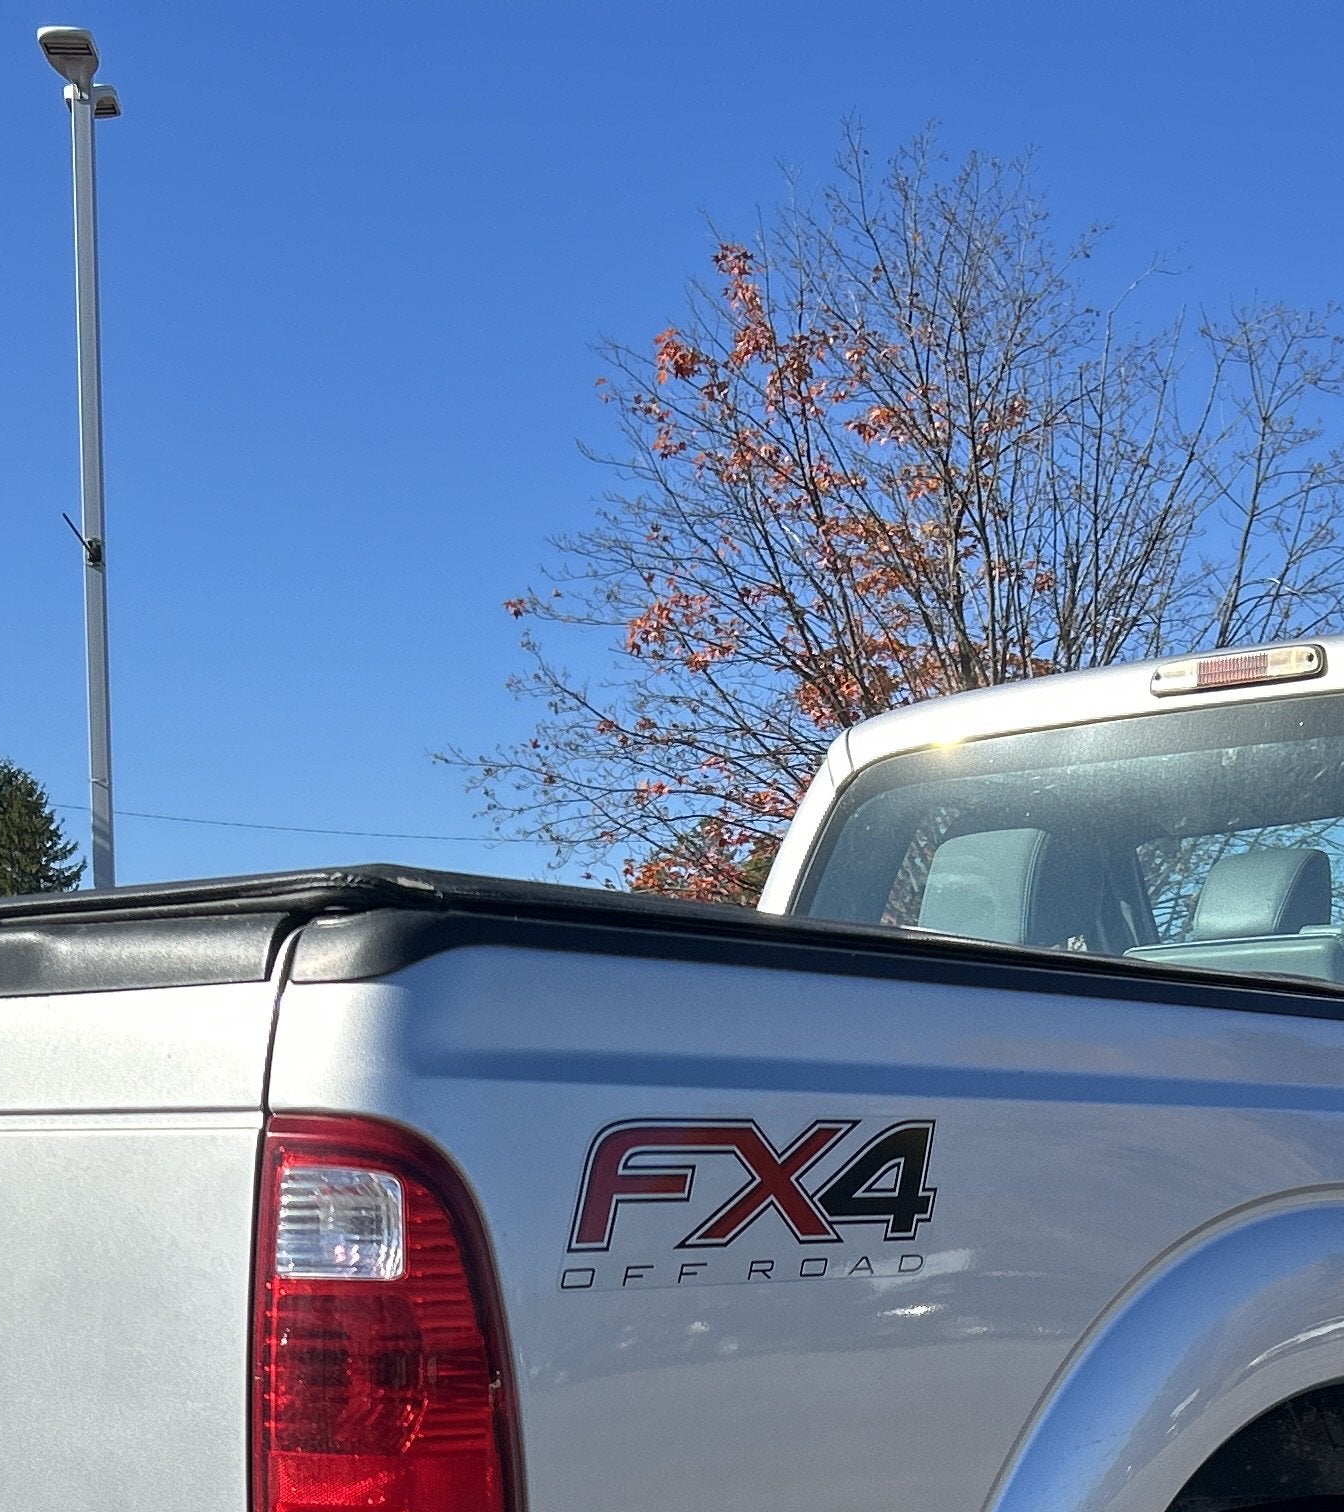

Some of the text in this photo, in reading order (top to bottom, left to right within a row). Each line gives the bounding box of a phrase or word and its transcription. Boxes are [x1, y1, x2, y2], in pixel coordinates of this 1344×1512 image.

[566, 1118, 938, 1253] FX4
[560, 1254, 925, 1290] OFF ROAD
